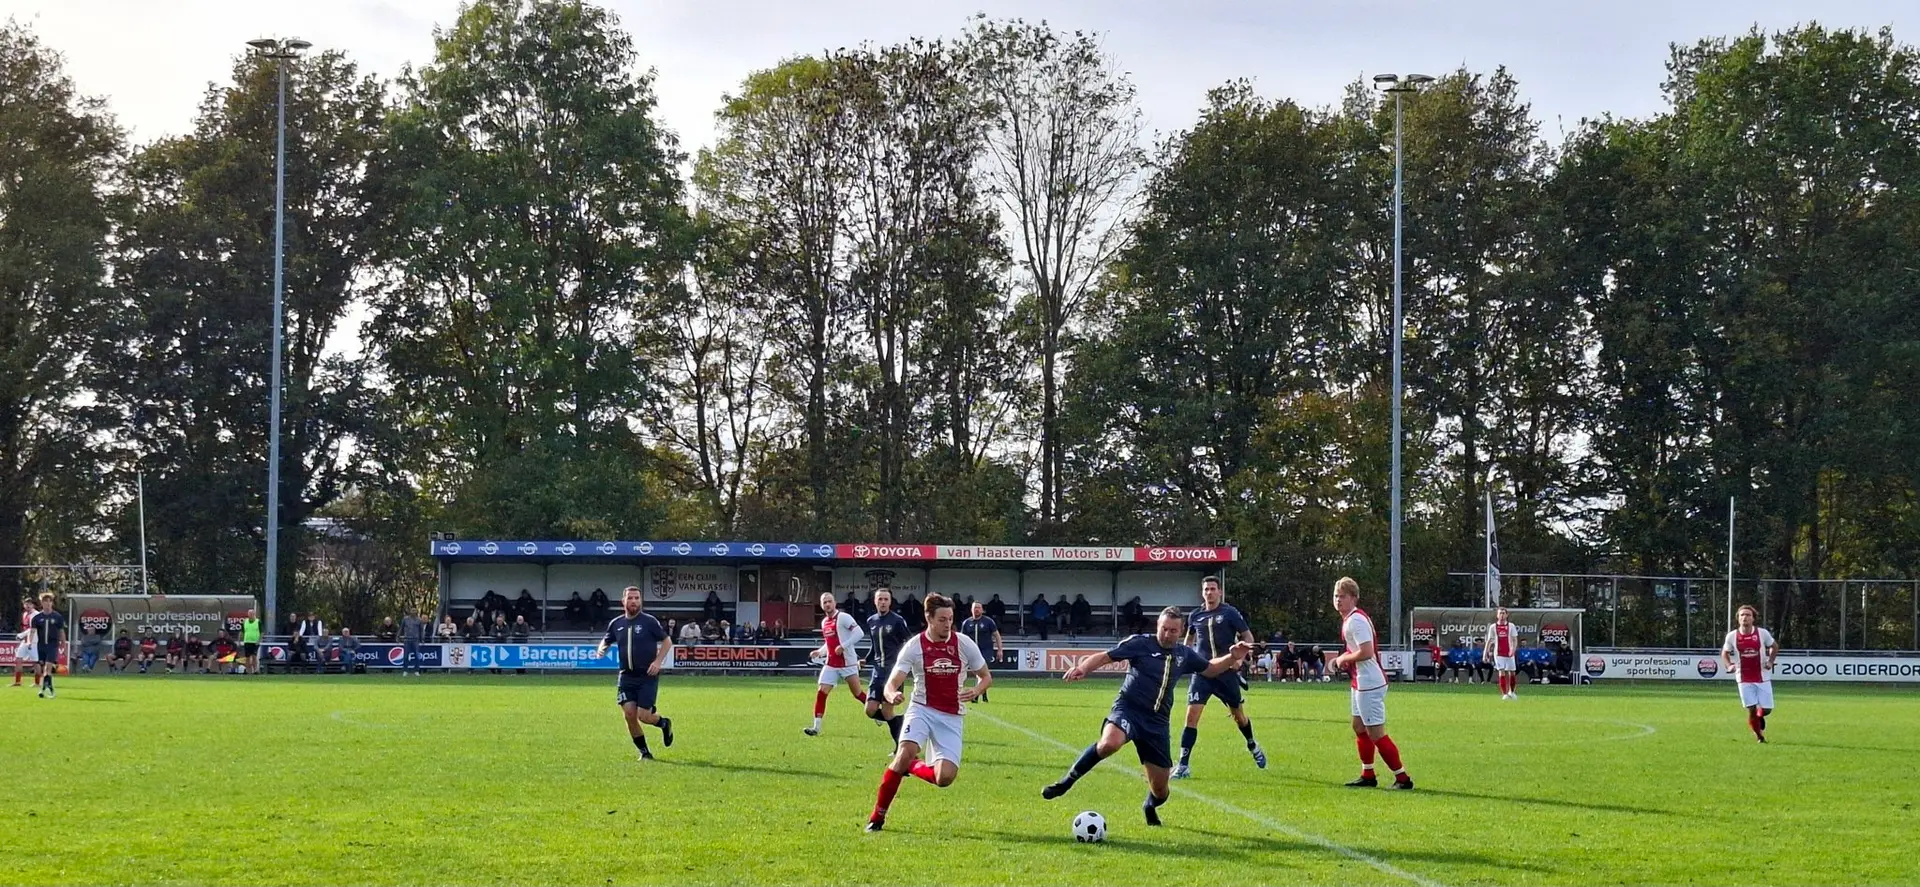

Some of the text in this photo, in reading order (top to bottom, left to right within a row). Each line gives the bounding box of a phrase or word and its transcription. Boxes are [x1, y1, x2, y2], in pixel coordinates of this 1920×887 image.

[872, 547, 921, 557] TOYOTA
[947, 548, 1122, 559] van Haasteren Motors BV
[1168, 549, 1217, 559] TOYOTA
[117, 610, 221, 624] your professional
[1441, 624, 1465, 634] your
[518, 646, 600, 660] Barendse
[1612, 657, 1690, 667] your professional
[1626, 667, 1676, 677] sportshop
[1782, 664, 1827, 675] 2000
